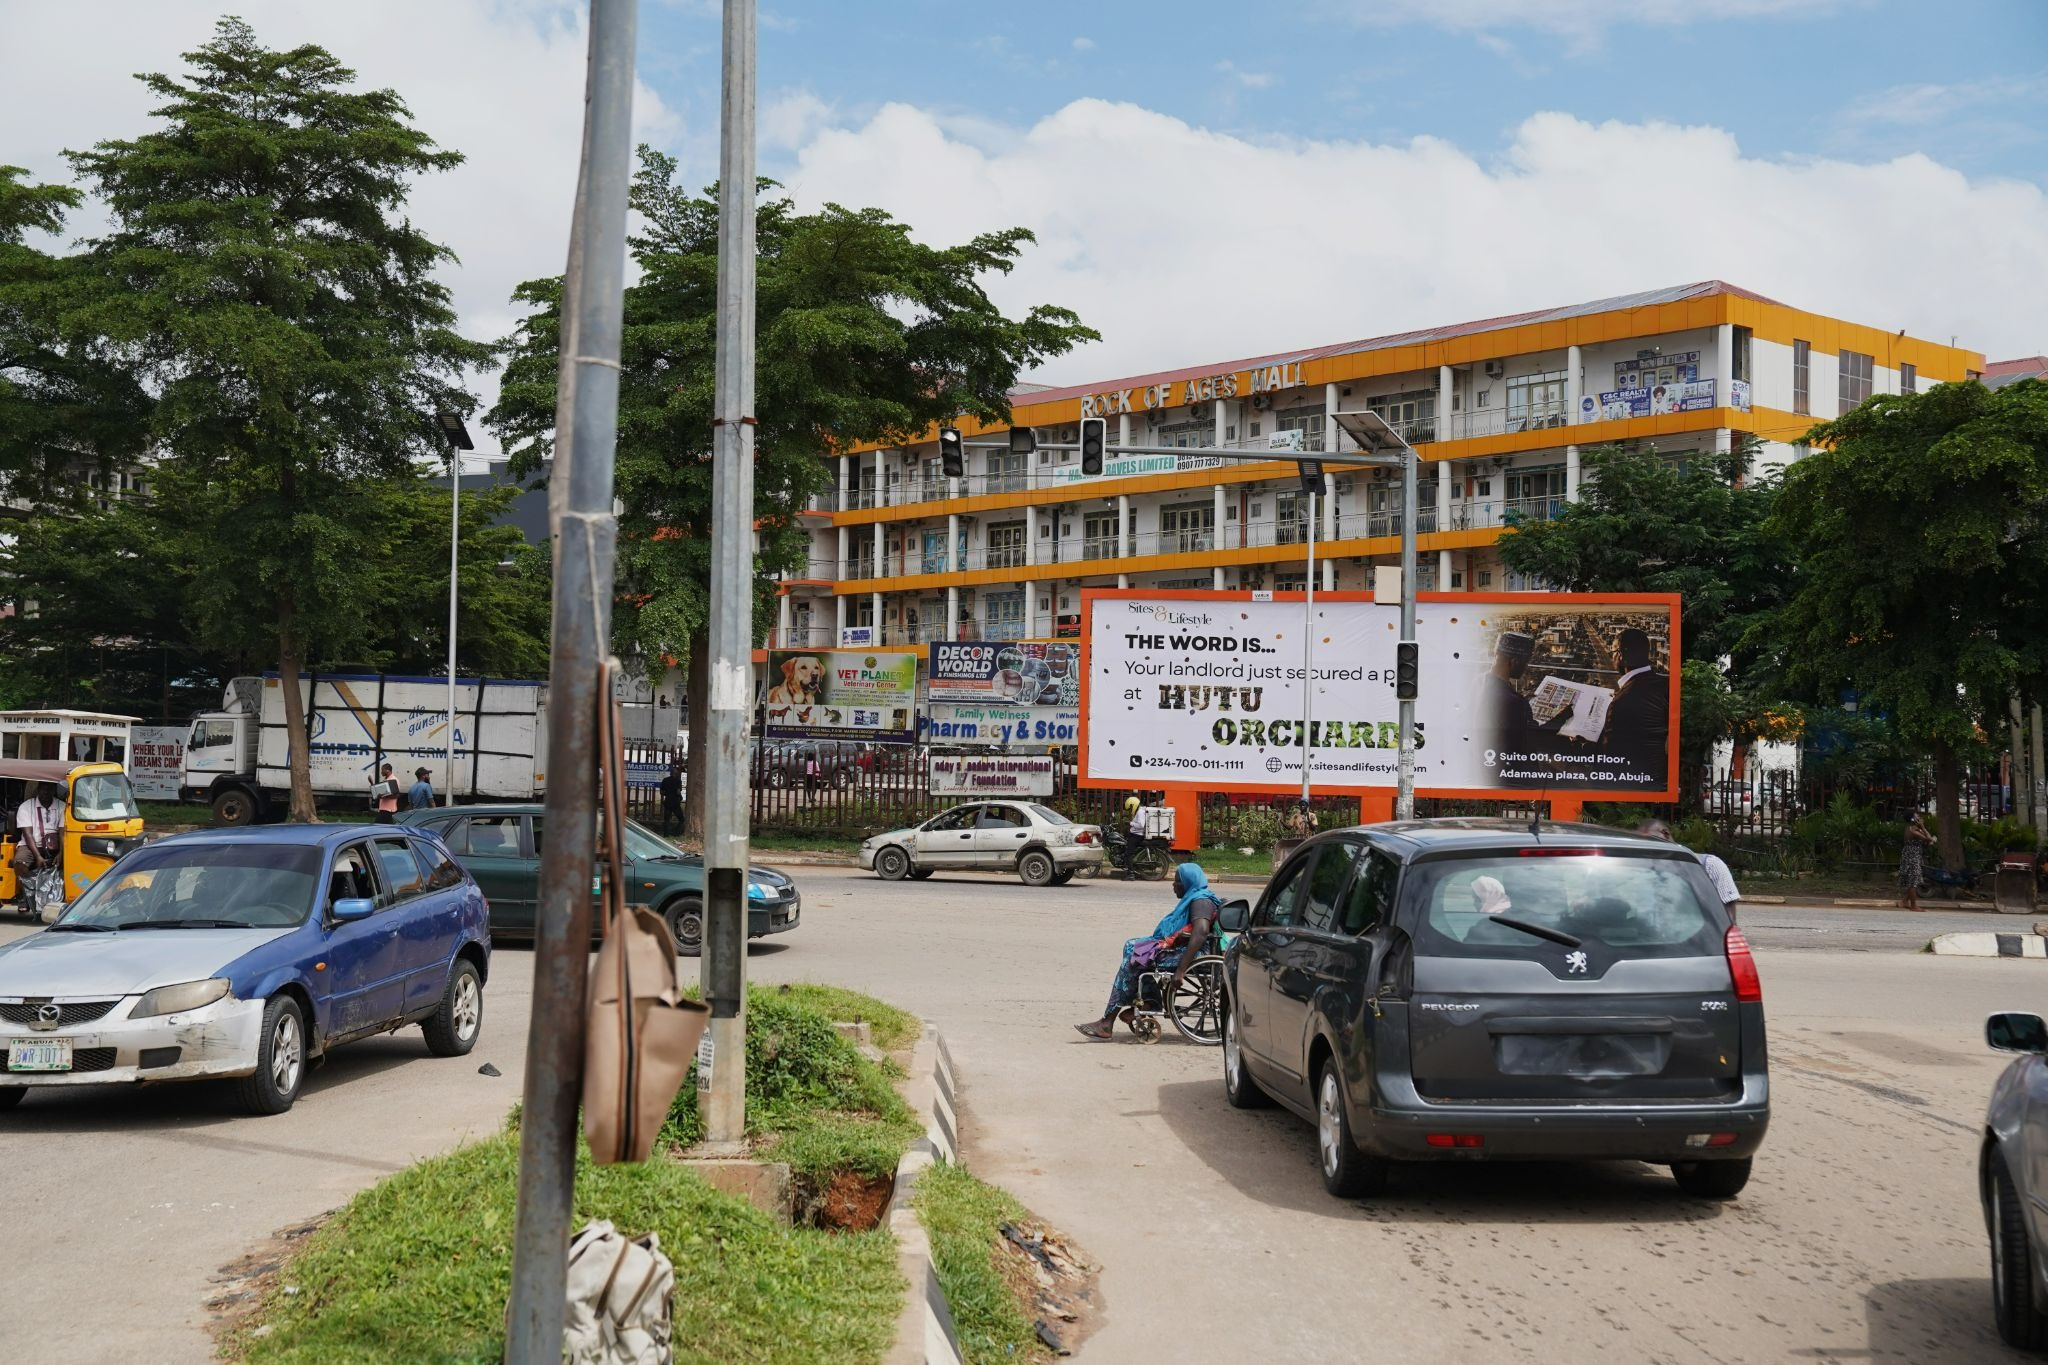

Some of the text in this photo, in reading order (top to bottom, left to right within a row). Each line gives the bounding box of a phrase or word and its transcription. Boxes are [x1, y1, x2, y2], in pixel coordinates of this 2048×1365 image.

[1081, 362, 1307, 418] ROCK OF AGES MALL
[1103, 461, 1136, 476] RAVELS
[1139, 457, 1175, 472] LIMITED
[1177, 460, 1190, 470] 0907
[1204, 457, 1221, 468] 7329
[1128, 602, 1212, 628] Sites & Lifestyle
[1125, 634, 1276, 654] THE WORD IS...
[938, 646, 994, 661] DECOR
[938, 659, 992, 672] WORLD
[1125, 660, 1396, 684] Your landlord just secured a p
[837, 670, 905, 681] VET PLANET
[843, 681, 897, 689] Veterinary Center
[1124, 686, 1142, 701] at
[1158, 684, 1263, 712] HUTU
[33, 717, 60, 725] OFFICER
[955, 708, 985, 721] Family
[101, 720, 127, 728] OFFICER
[919, 717, 1079, 744] Pharmacy & Stor
[1211, 717, 1426, 751] ORCHARDS
[133, 744, 184, 757] WHERE YOUR LE
[310, 743, 370, 756] EMPER
[134, 756, 162, 768] DREAMS
[1144, 757, 1244, 770] +234-700-011-1111
[1500, 752, 1527, 761] Suite
[1529, 753, 1552, 764] 001,
[1553, 753, 1595, 763] Ground
[965, 761, 995, 772] eaders
[971, 774, 1017, 786] Foundation
[1499, 769, 1654, 783] Adamawa plaza, CBD, Abuja.
[1421, 1003, 1480, 1012] PEUGEOT
